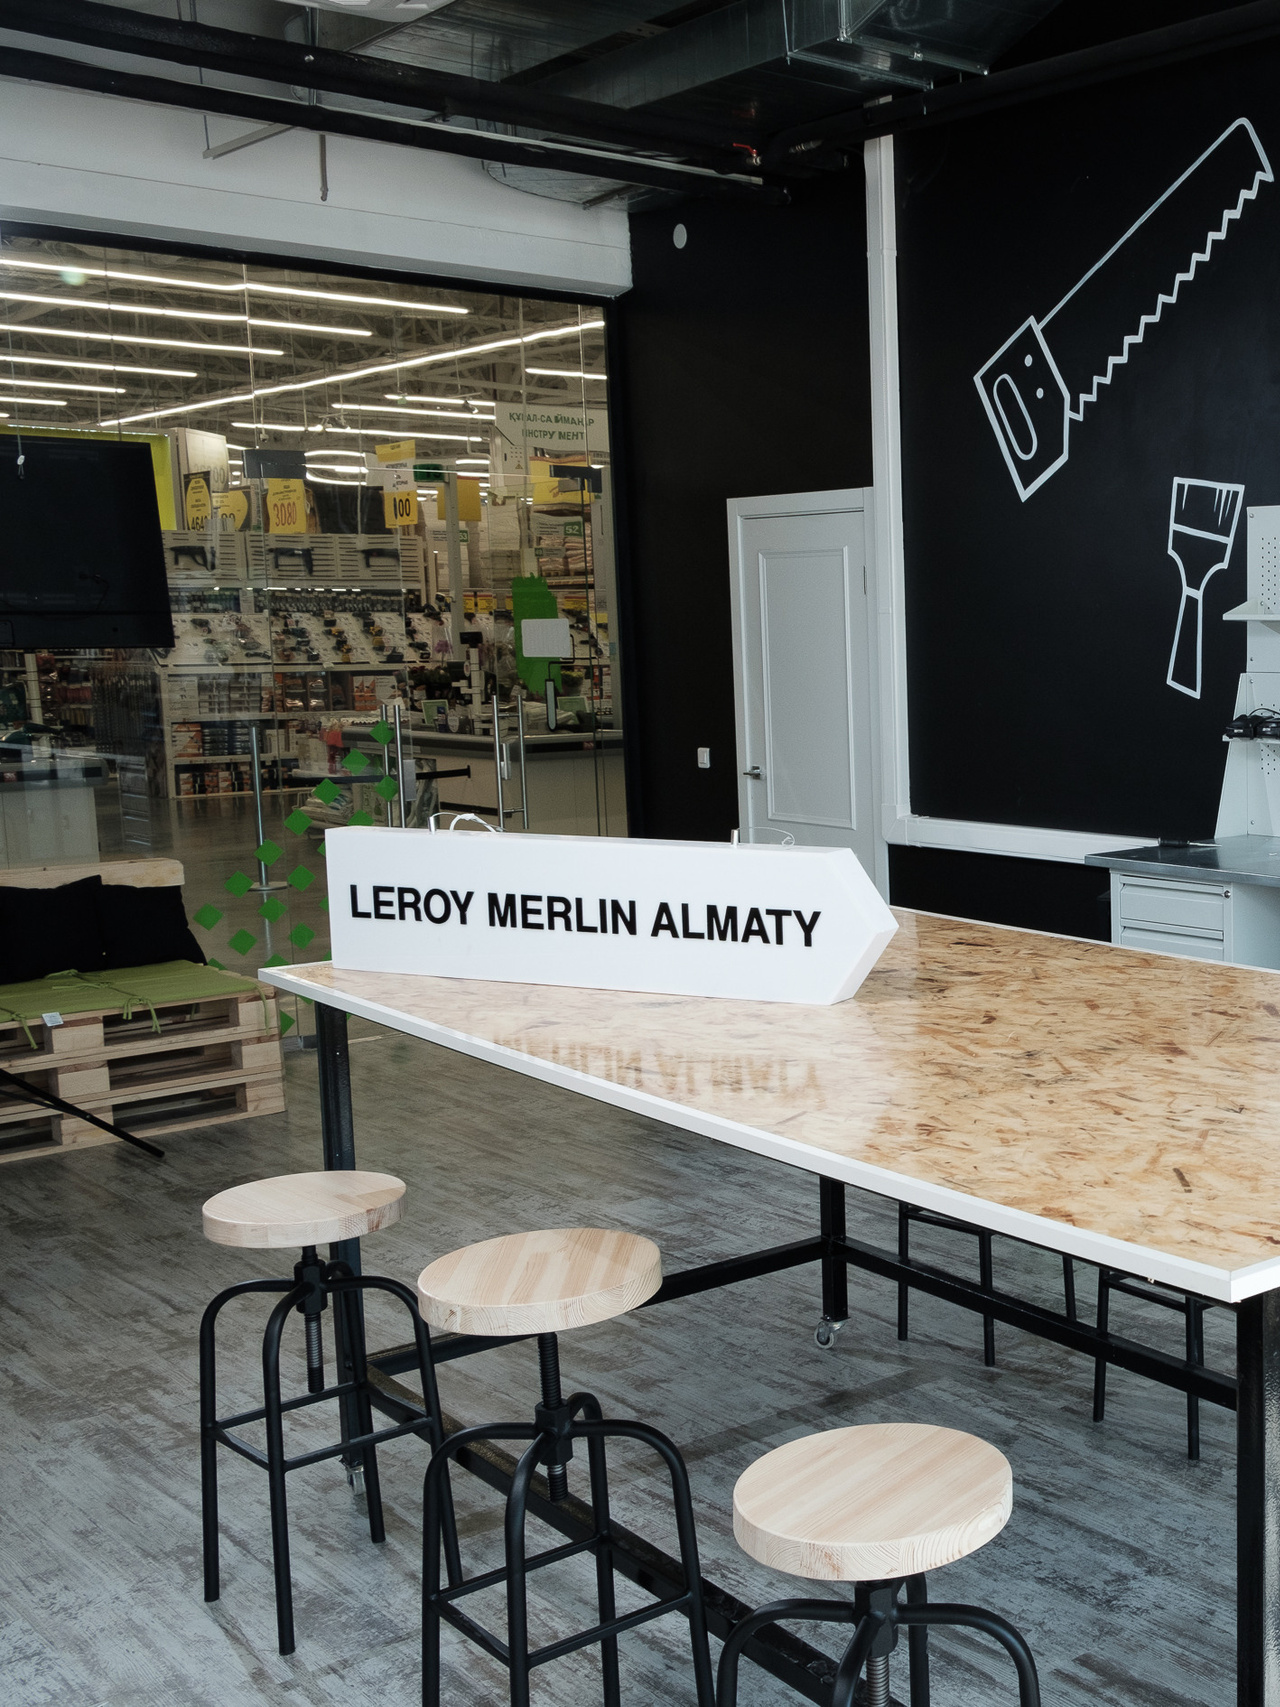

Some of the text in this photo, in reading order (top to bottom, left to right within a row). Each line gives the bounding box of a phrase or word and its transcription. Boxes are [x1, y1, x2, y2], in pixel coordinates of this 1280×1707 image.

[273, 502, 297, 526] 3080
[565, 525, 579, 534] 52
[350, 884, 822, 947] LEROY MERLIN ALMATY
